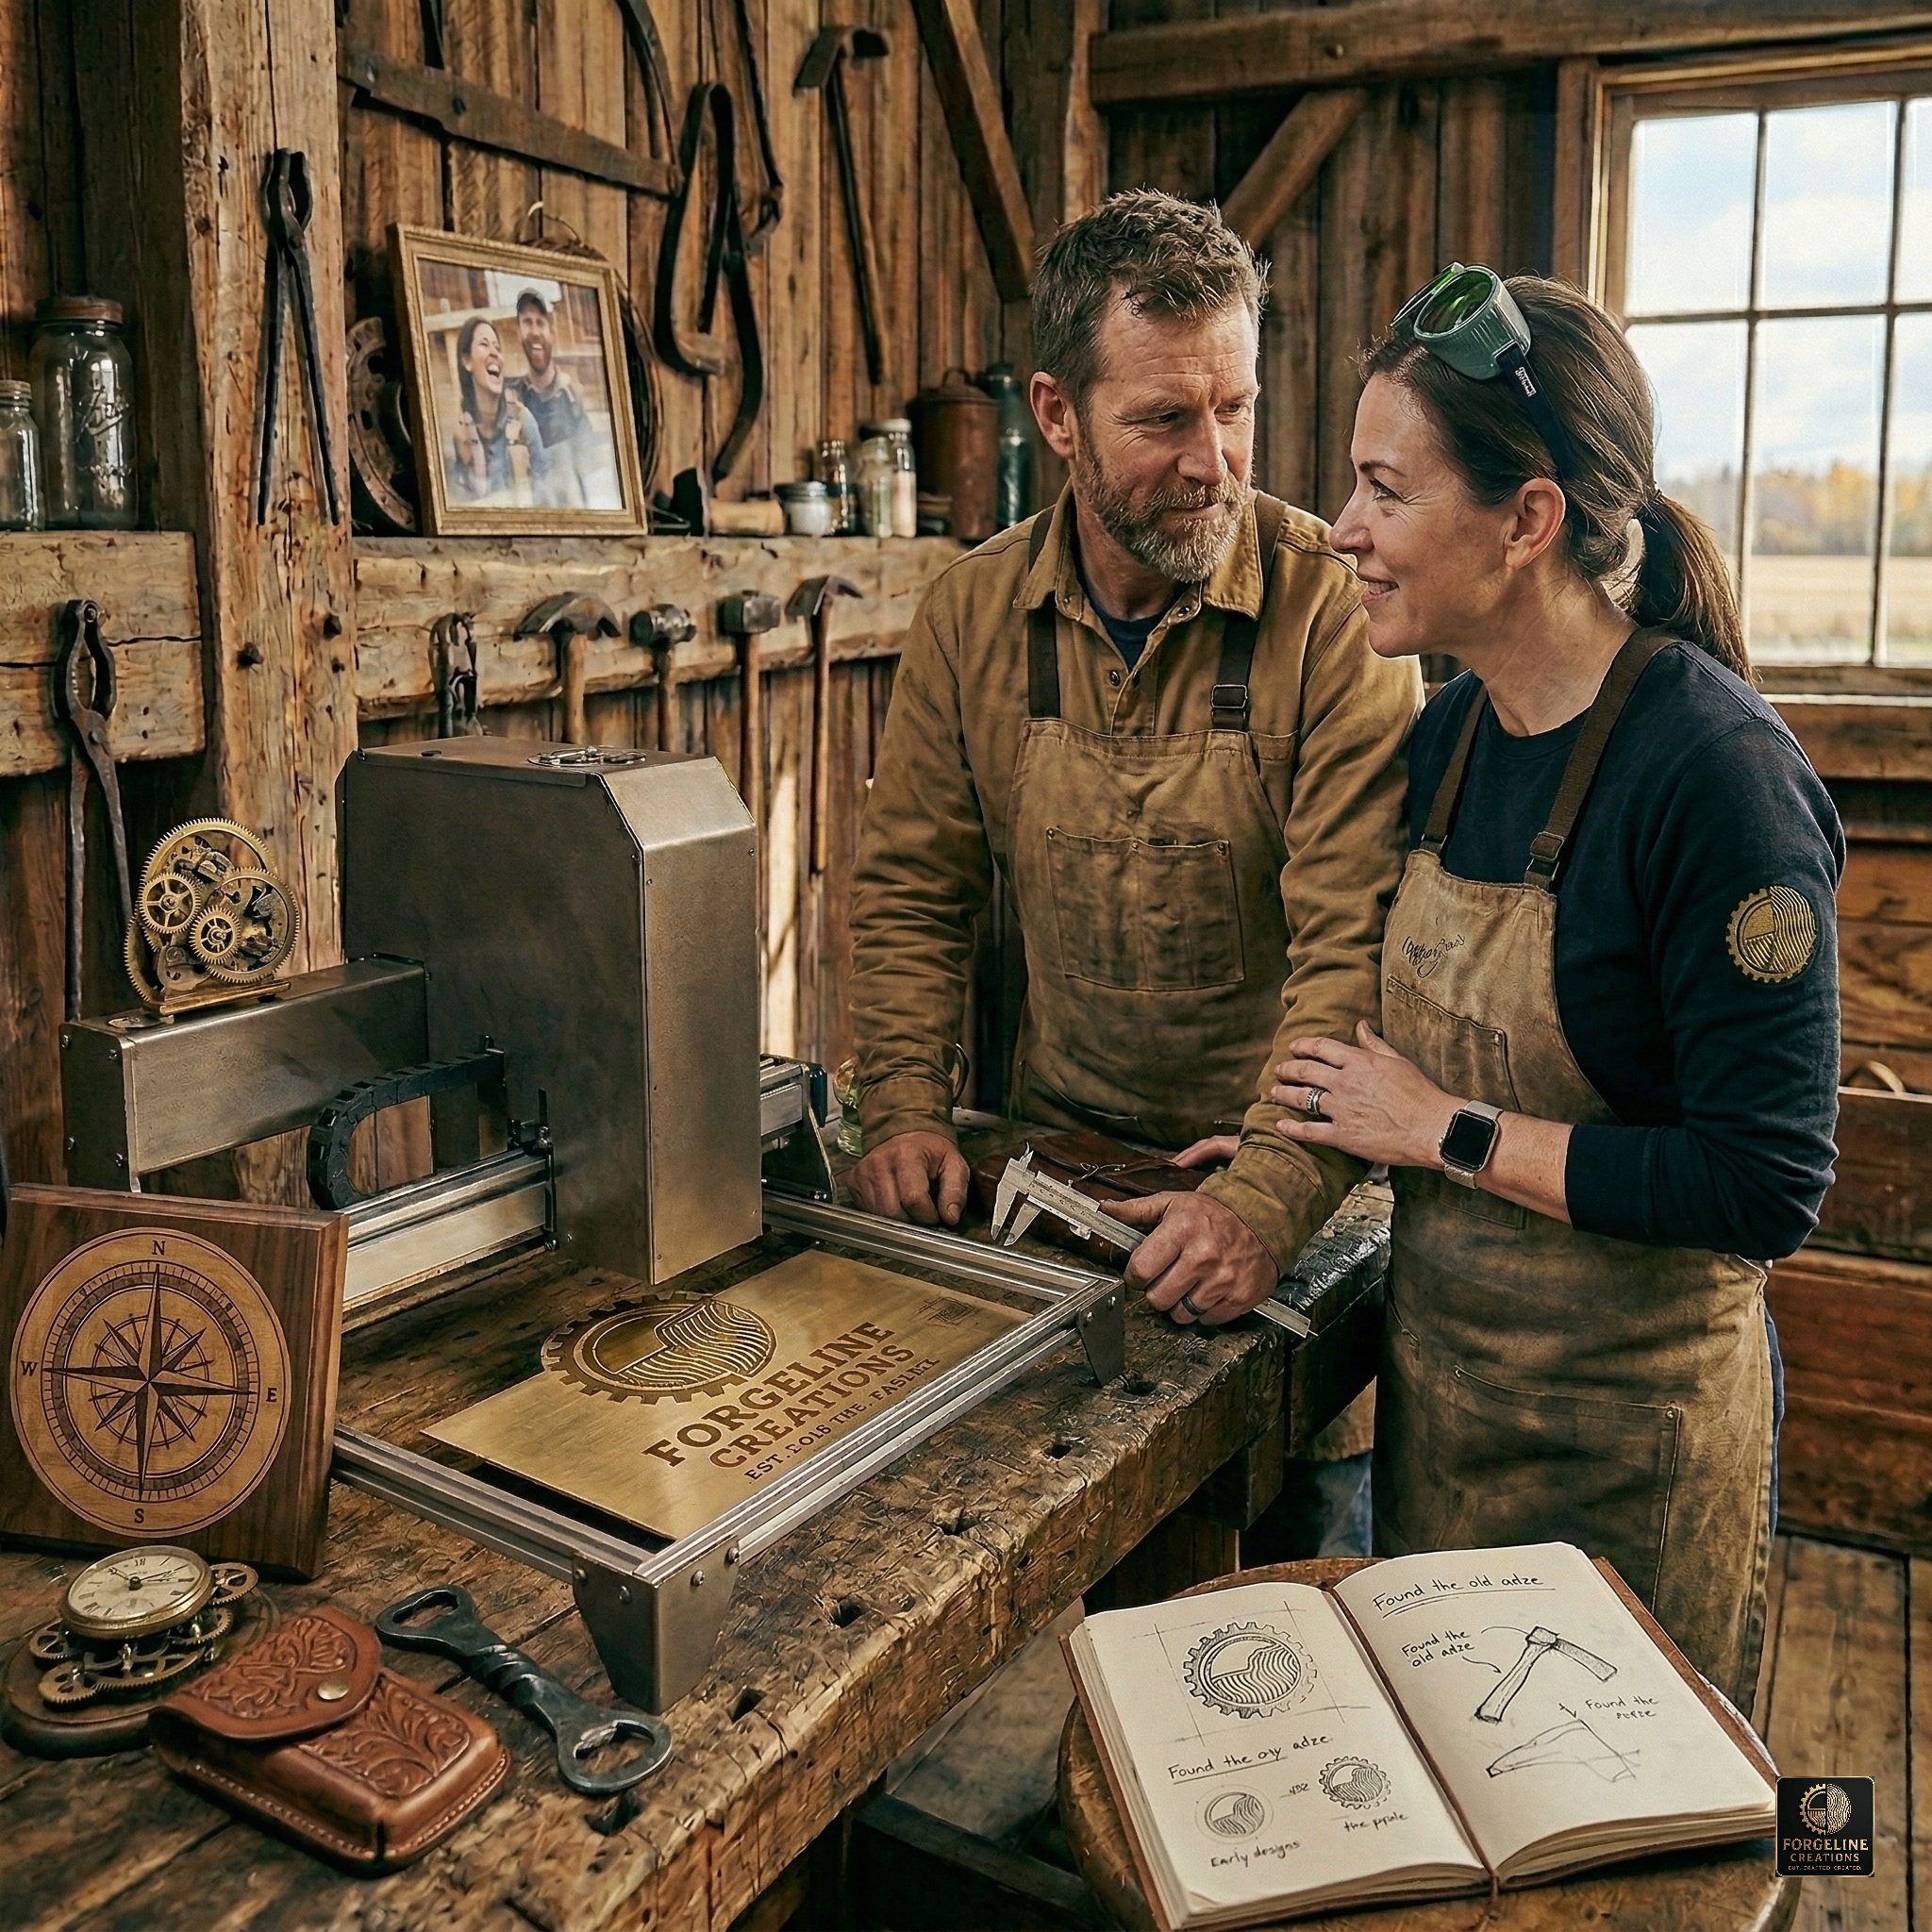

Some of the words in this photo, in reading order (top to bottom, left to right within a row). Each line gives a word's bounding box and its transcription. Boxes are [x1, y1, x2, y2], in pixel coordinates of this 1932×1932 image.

[152, 1240, 166, 1256] N
[20, 1360, 38, 1375] W
[265, 1387, 278, 1404] E
[641, 1321, 896, 1468] FORGELINE
[708, 1343, 915, 1469] CREATIONS
[134, 1507, 145, 1524] S
[1372, 1583, 1426, 1611] Found
[1431, 1578, 1464, 1592] the
[1469, 1574, 1493, 1589] old
[1501, 1573, 1544, 1587] adze
[1401, 1633, 1441, 1657] Found
[1444, 1629, 1472, 1642] the
[1411, 1653, 1435, 1669] old
[1441, 1640, 1476, 1657] adze
[1585, 1695, 1627, 1710] Found
[1633, 1694, 1660, 1706] the
[1168, 1757, 1215, 1780] Found
[1223, 1755, 1253, 1768] the
[1292, 1735, 1331, 1751] adze
[1343, 1821, 1369, 1833] the
[1210, 1852, 1250, 1869] Early
[1254, 1840, 1302, 1860] designs
